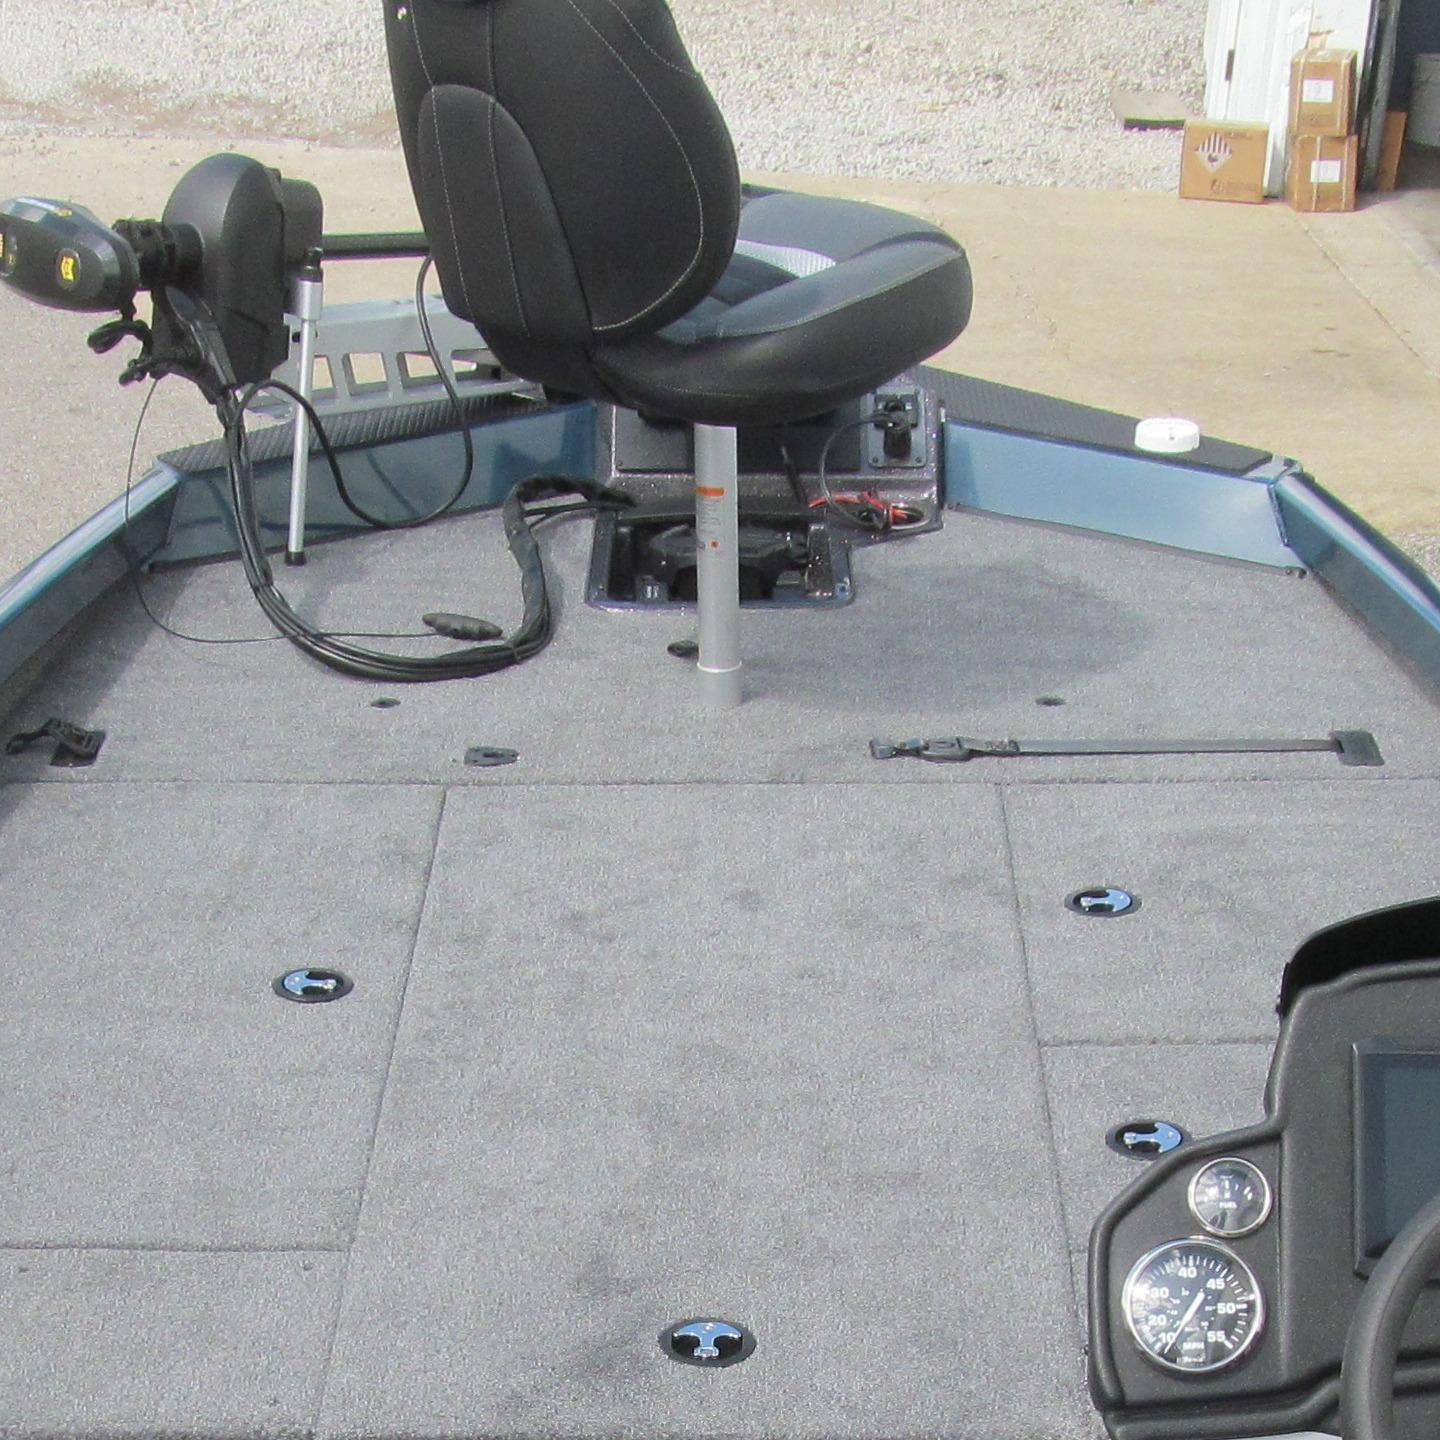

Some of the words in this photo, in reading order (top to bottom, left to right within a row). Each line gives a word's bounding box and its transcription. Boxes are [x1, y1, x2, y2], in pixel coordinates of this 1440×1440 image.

[1178, 1266, 1197, 1278] 40
[1206, 1278, 1226, 1290] 45
[1150, 1287, 1169, 1299] 30
[1217, 1302, 1236, 1314] 50
[1148, 1314, 1167, 1326] 20
[1159, 1331, 1176, 1344] 10
[1207, 1330, 1226, 1342] 55
